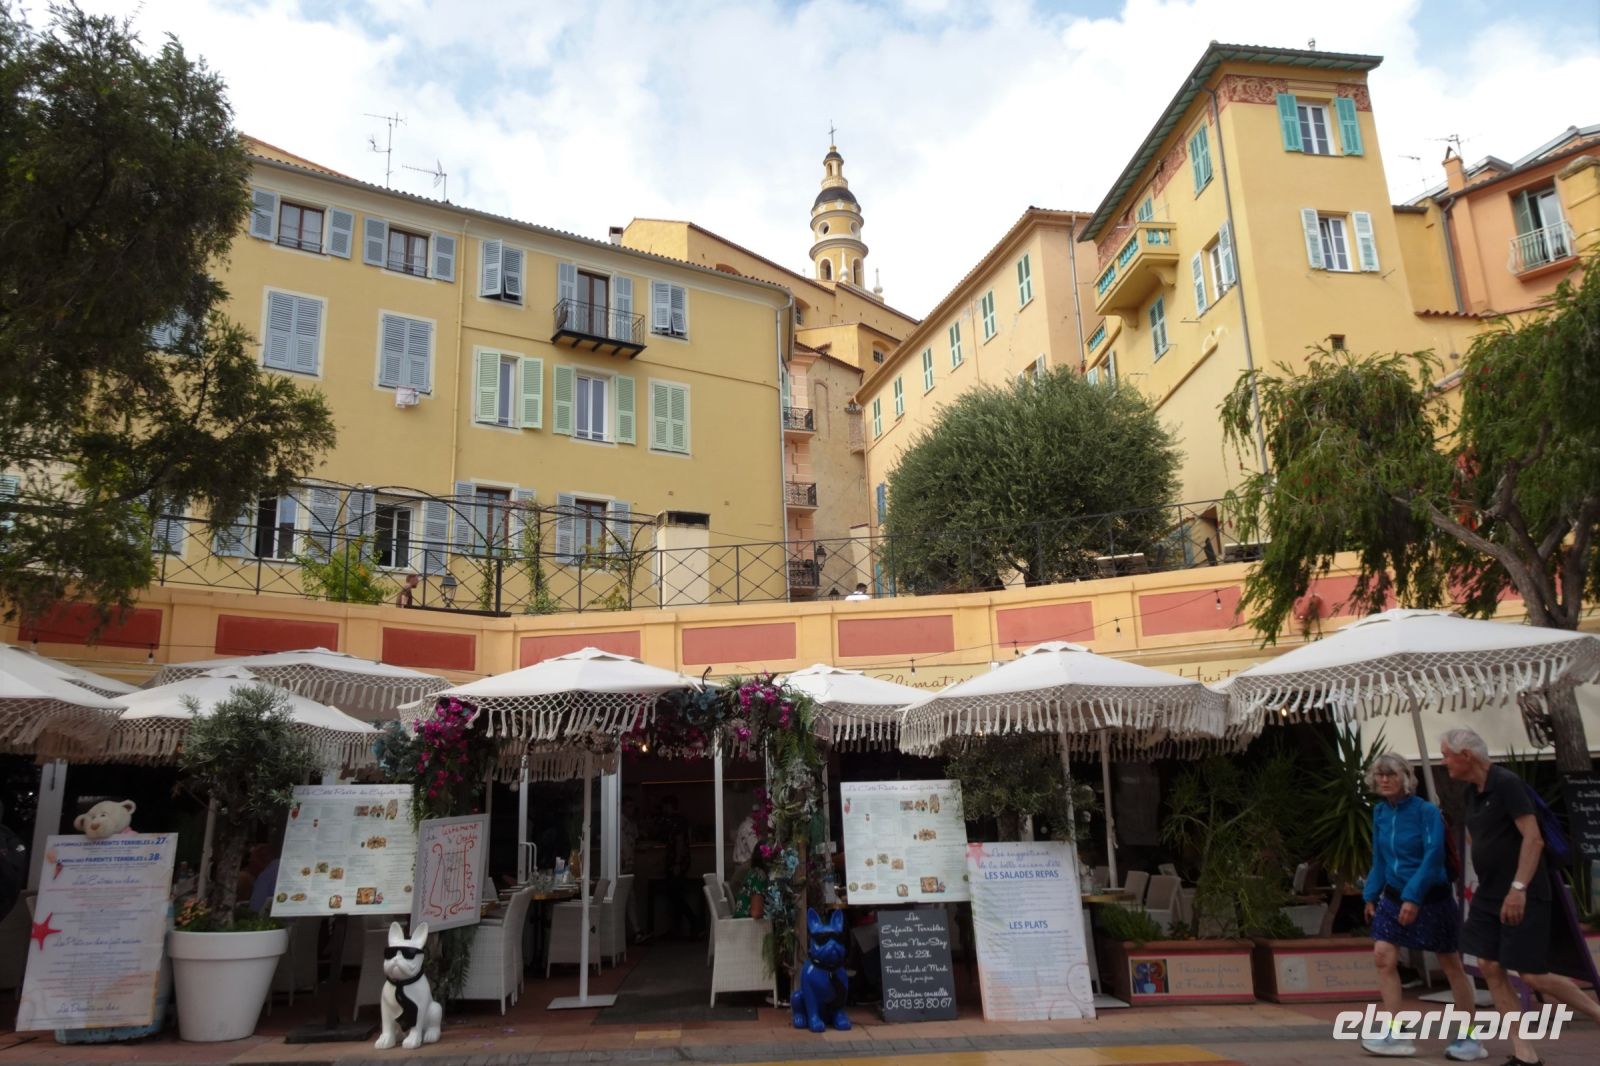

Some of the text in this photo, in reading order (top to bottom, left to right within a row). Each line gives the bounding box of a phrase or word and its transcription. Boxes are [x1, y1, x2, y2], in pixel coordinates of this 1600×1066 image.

[984, 869, 1059, 880] LES SALADES REPAS
[881, 923, 946, 937] Enfants Terribles
[1008, 920, 1049, 930] LES PLATS
